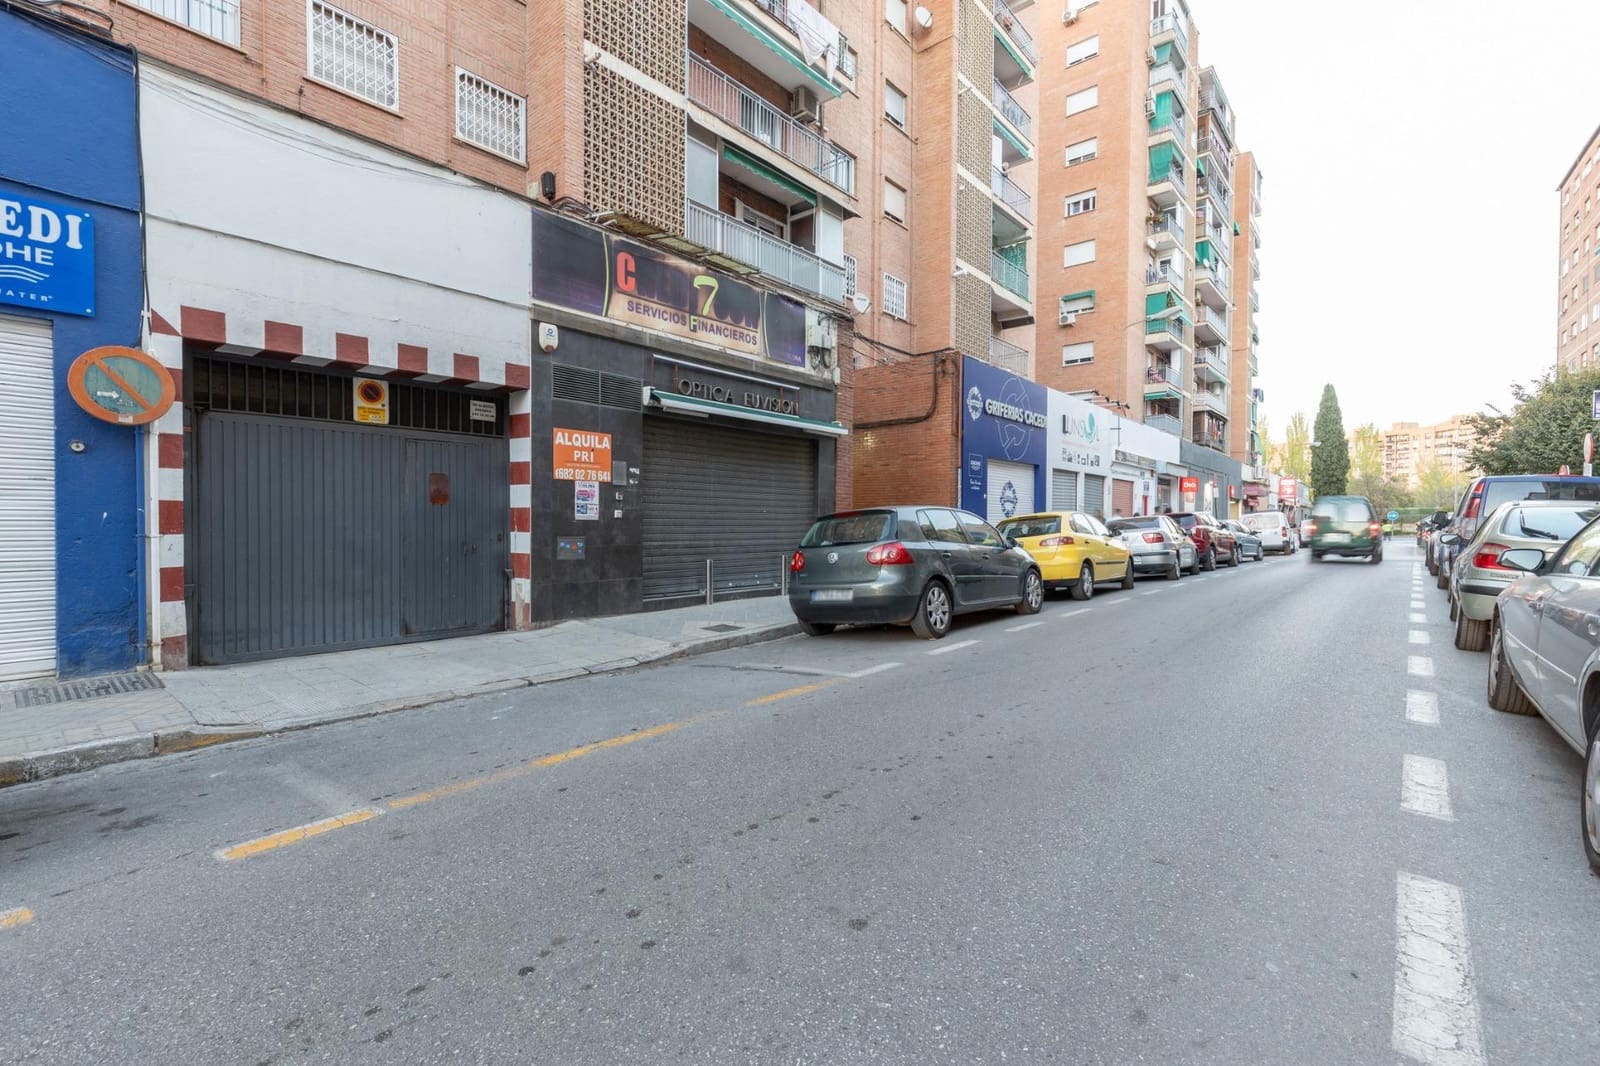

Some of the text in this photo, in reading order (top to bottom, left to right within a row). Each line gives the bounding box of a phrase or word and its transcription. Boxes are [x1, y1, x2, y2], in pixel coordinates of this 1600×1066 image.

[0, 241, 54, 266] HE
[0, 288, 48, 302] ATER
[616, 251, 719, 316] C 7
[627, 300, 758, 346] SERVICIOS FINANCIEROS
[678, 379, 734, 403] OPTICA
[556, 431, 610, 449] ALQUILA
